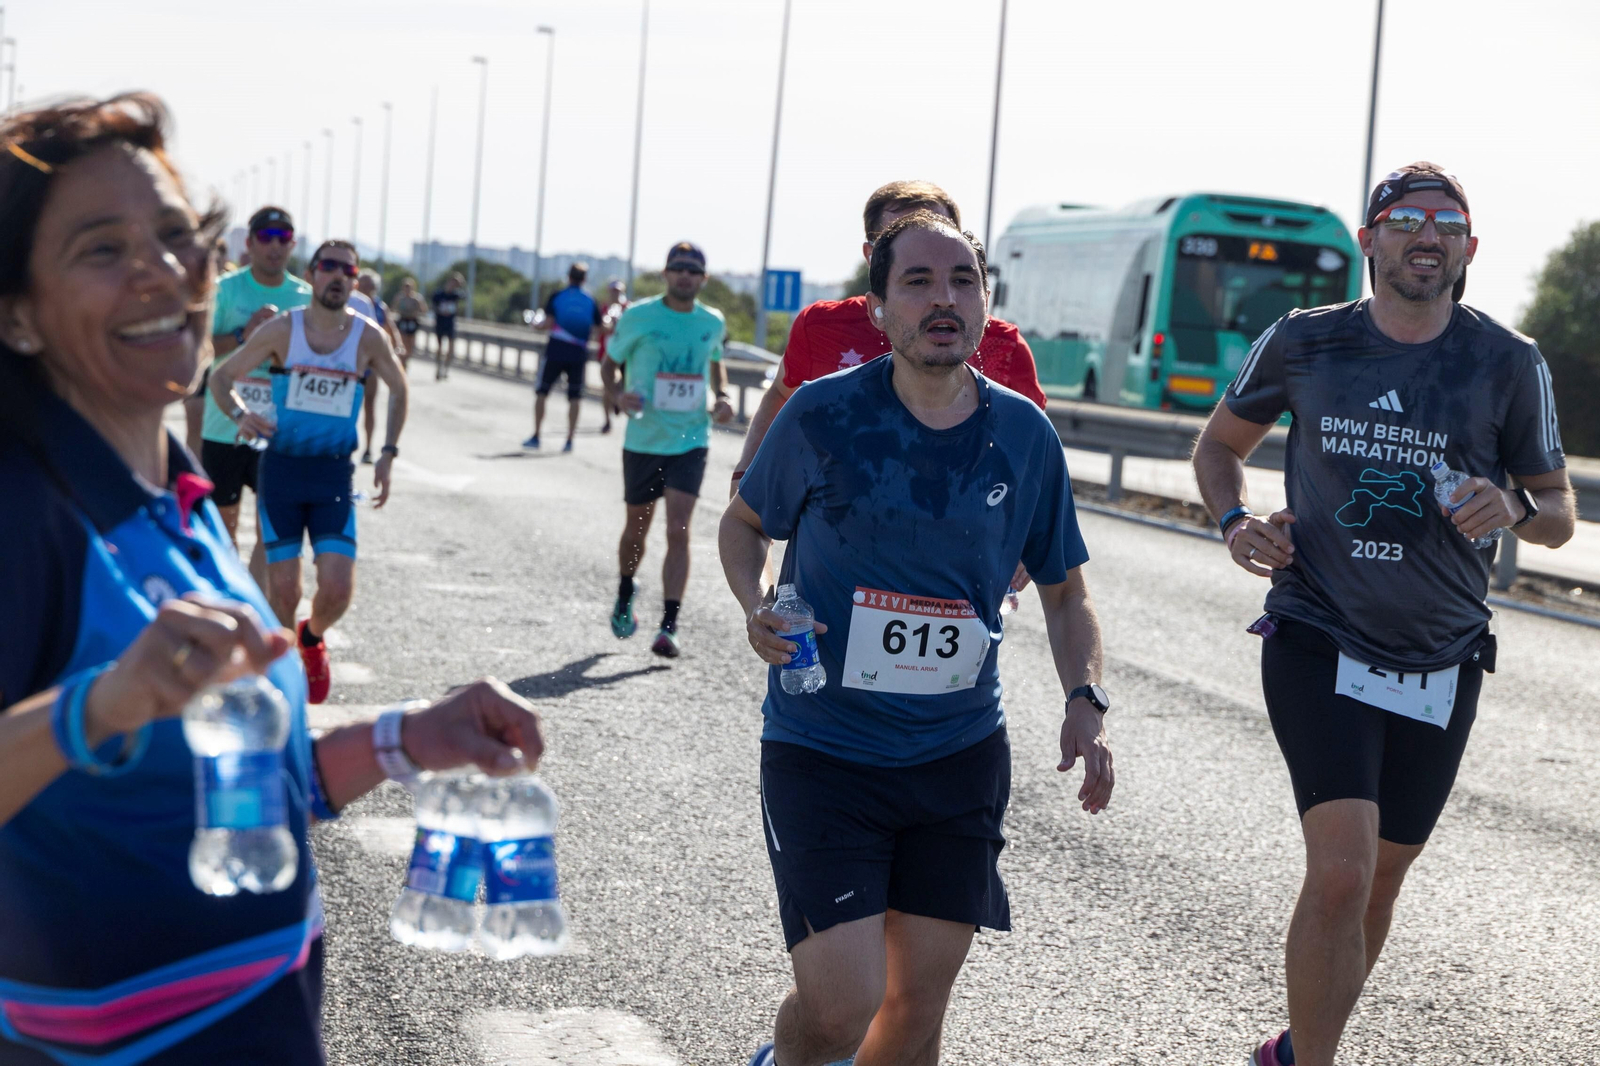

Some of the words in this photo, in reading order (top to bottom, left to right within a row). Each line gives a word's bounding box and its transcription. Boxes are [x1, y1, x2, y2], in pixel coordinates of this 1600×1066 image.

[241, 385, 272, 405] 503
[305, 377, 341, 397] 467
[668, 382, 695, 398] 751
[1321, 416, 1368, 436] BMW
[1373, 423, 1448, 449] BERLIN
[1322, 436, 1445, 467] MARATHON
[1351, 539, 1404, 561] 2023
[858, 591, 907, 610] XXVI
[910, 599, 941, 608] MEDIA
[883, 620, 960, 659] 613
[895, 664, 919, 672] MANUEL
[1386, 686, 1403, 695] PORTO
